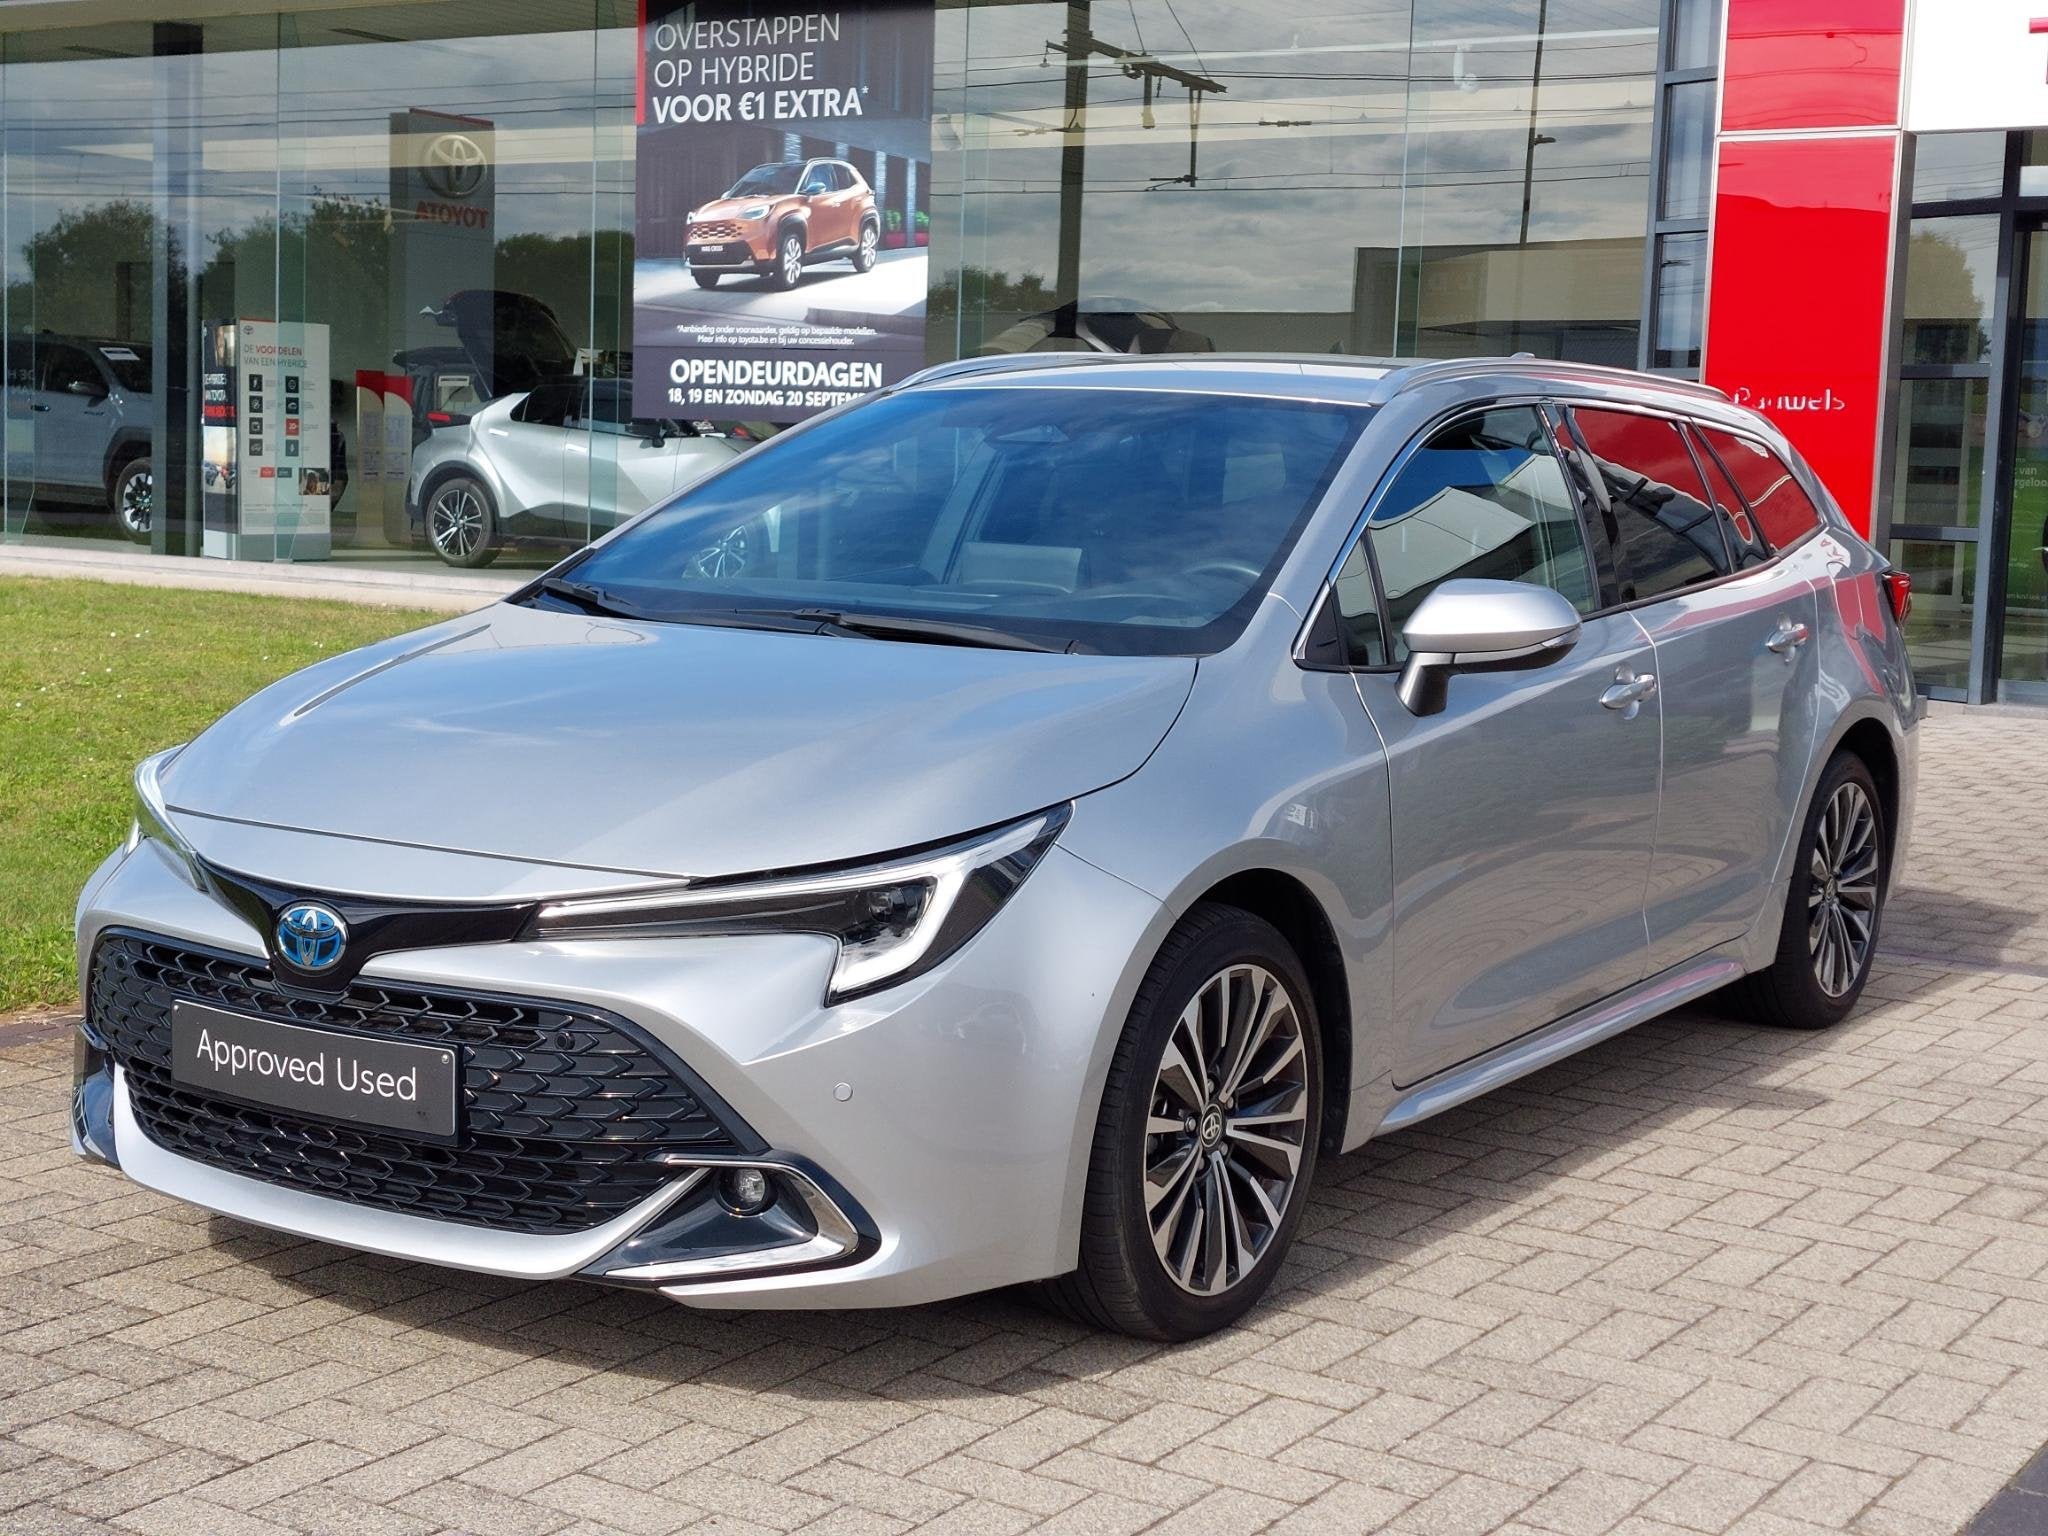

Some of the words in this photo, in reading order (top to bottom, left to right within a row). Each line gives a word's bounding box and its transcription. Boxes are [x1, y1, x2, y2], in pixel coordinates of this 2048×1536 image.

[655, 13, 840, 51] OVERSTAPPEN
[654, 59, 692, 88] OP
[701, 52, 814, 85] HYBRIDE
[652, 93, 732, 124] VOOR
[738, 91, 765, 121] €1
[715, 335, 728, 343] info
[728, 337, 738, 345] op
[778, 336, 787, 346] bij
[801, 327, 810, 336] op
[670, 358, 882, 388] OPENDEURDAGEN
[668, 388, 686, 405] 18,
[688, 389, 702, 403] 19
[704, 389, 724, 404] EN
[725, 389, 785, 406] ZONDAG
[786, 390, 803, 406] 20
[197, 1028, 325, 1086] Approved
[336, 1057, 416, 1101] Used
